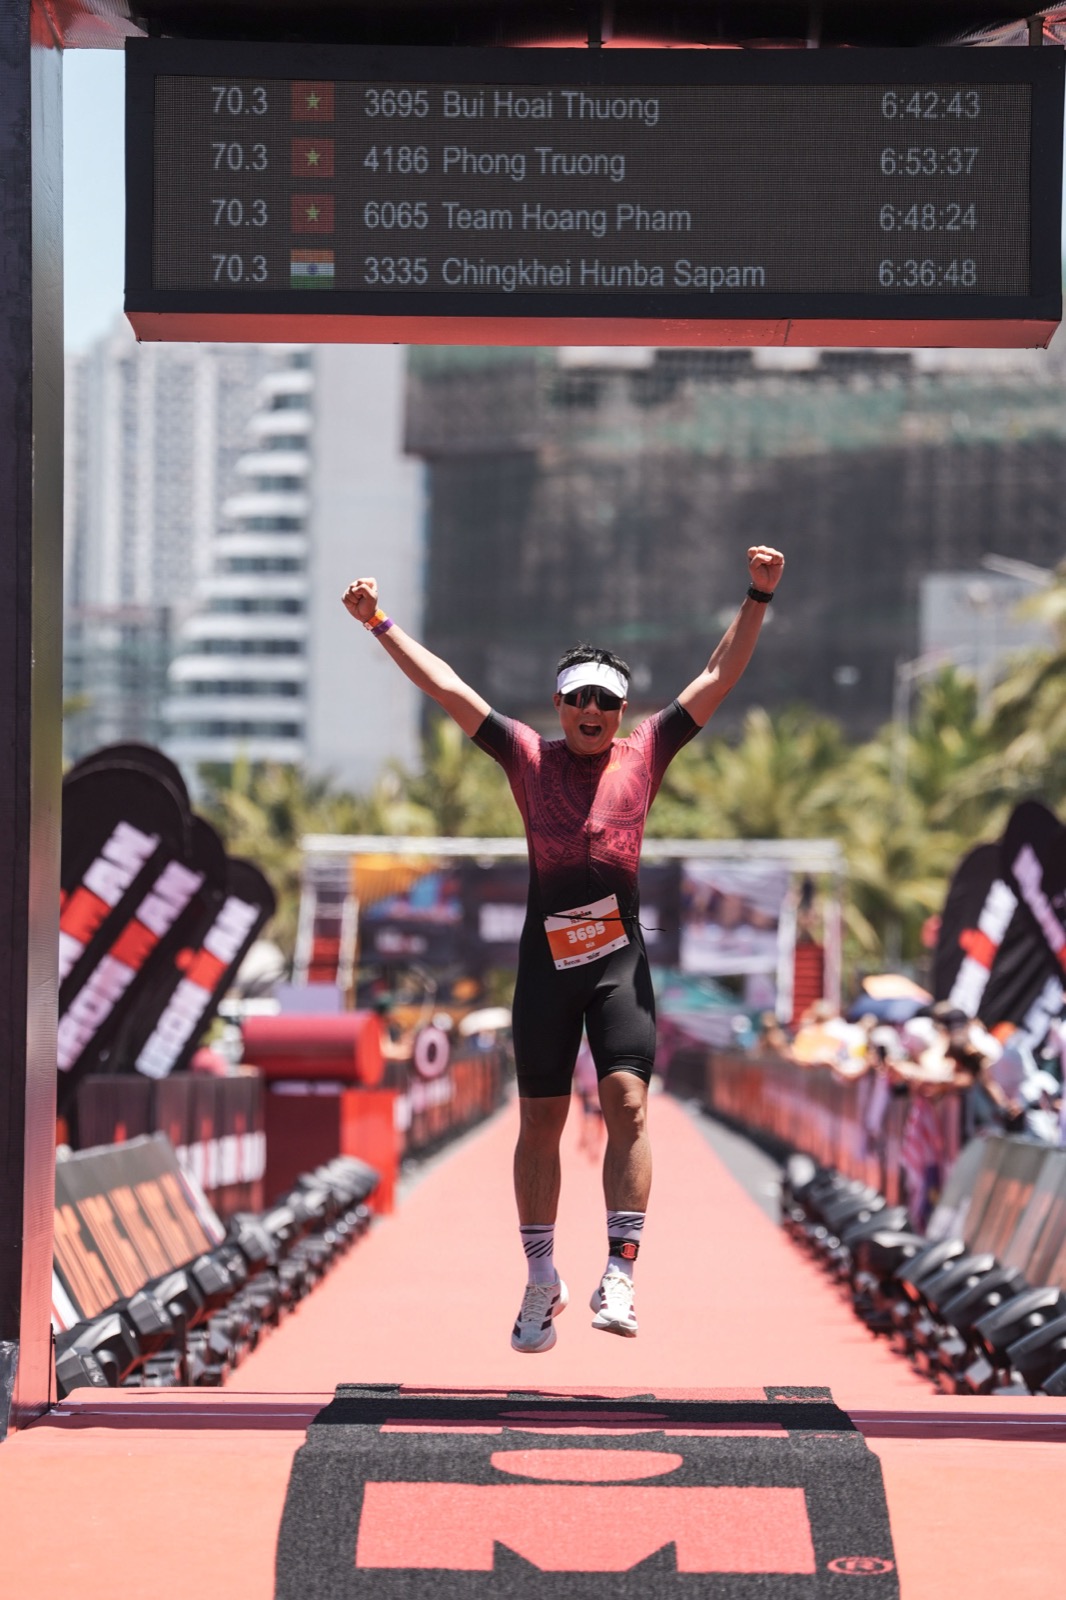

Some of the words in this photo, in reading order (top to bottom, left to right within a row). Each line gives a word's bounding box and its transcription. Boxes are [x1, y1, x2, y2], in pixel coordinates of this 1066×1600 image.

[211, 86, 268, 115] 70.3
[363, 89, 429, 118] 3695
[442, 90, 484, 119] Bui
[493, 90, 552, 119] Hoai
[560, 90, 660, 127] Thuong
[881, 91, 981, 119] 6:42:43
[211, 142, 268, 171] 70.3
[363, 145, 429, 174] 4186
[442, 147, 526, 182] Phong
[535, 146, 626, 182] Truong
[881, 147, 979, 175] 6:53:37
[211, 199, 268, 226] 70.3
[363, 201, 429, 230] 6065
[441, 202, 513, 230] Team
[522, 203, 607, 238] Hoang
[616, 203, 692, 231] Pham
[879, 203, 978, 231] 6:48:24
[211, 254, 268, 282] 70.3
[363, 256, 429, 285] 3335
[441, 256, 571, 292] Chingkhei
[580, 258, 665, 287] Hunba
[673, 258, 766, 293] Sapam
[878, 258, 977, 287] 6:36:48
[566, 920, 606, 944] 3695
